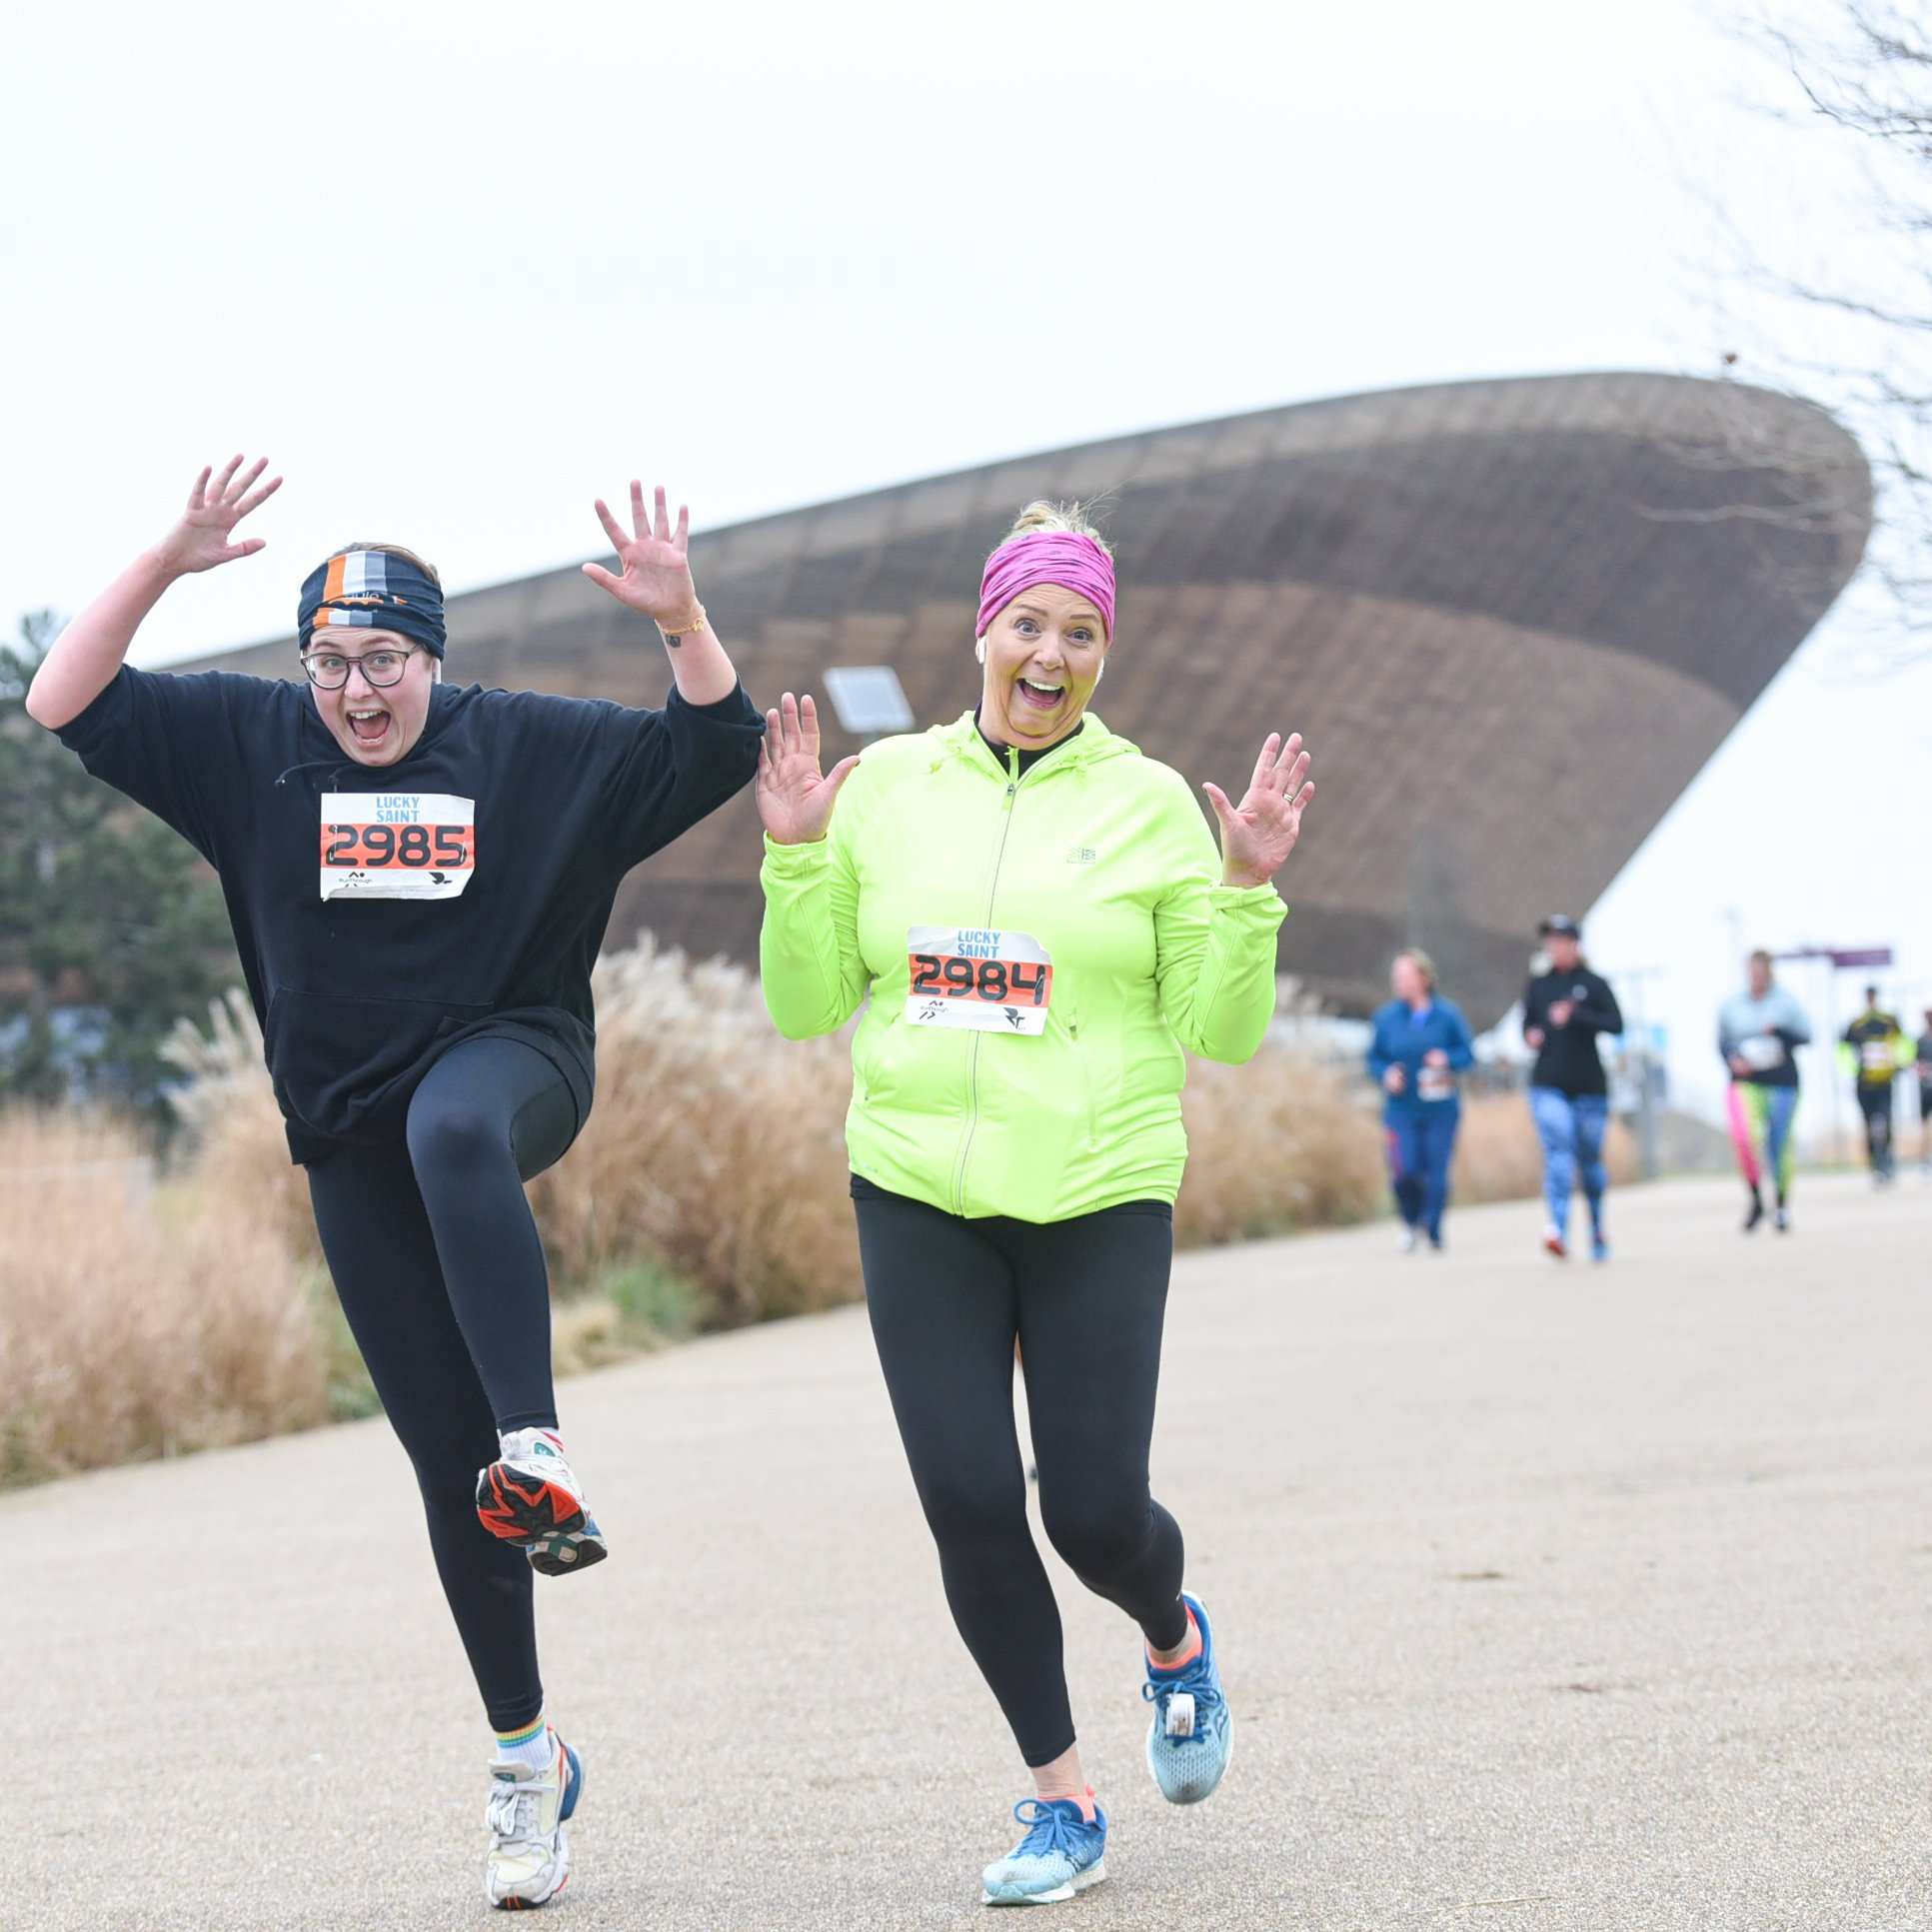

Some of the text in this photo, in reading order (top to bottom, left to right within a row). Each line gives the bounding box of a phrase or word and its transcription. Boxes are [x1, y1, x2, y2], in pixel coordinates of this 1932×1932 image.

[376, 797, 420, 809] LUCKY
[376, 810, 420, 823] SAINT
[326, 825, 468, 867] 2985
[958, 930, 1000, 945] LUCKY
[958, 943, 999, 959] SAINT
[913, 955, 1045, 1005] 2984
